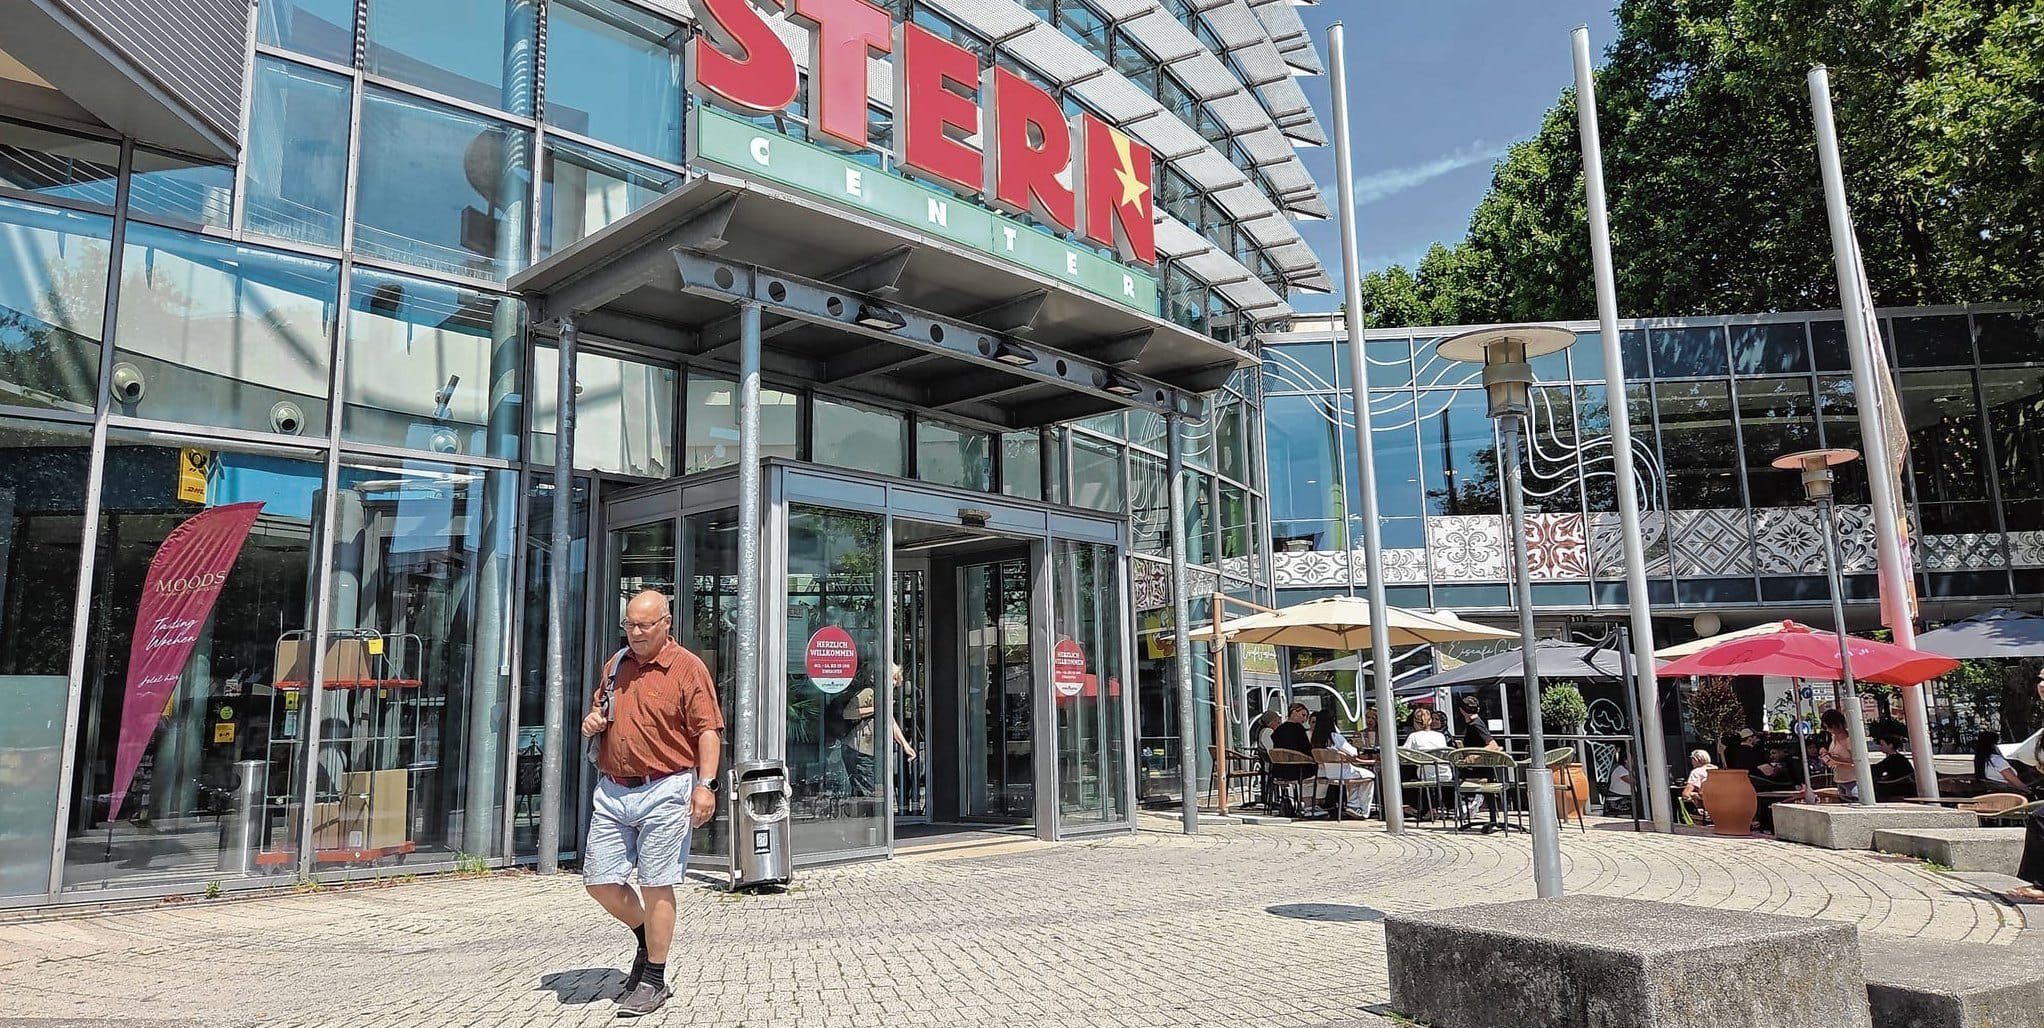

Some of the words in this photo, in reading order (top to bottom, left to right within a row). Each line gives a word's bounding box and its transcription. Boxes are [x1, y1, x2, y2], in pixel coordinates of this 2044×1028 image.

[686, 0, 1155, 266] STERN
[750, 137, 1136, 298] CENTER
[155, 570, 226, 592] MOODS
